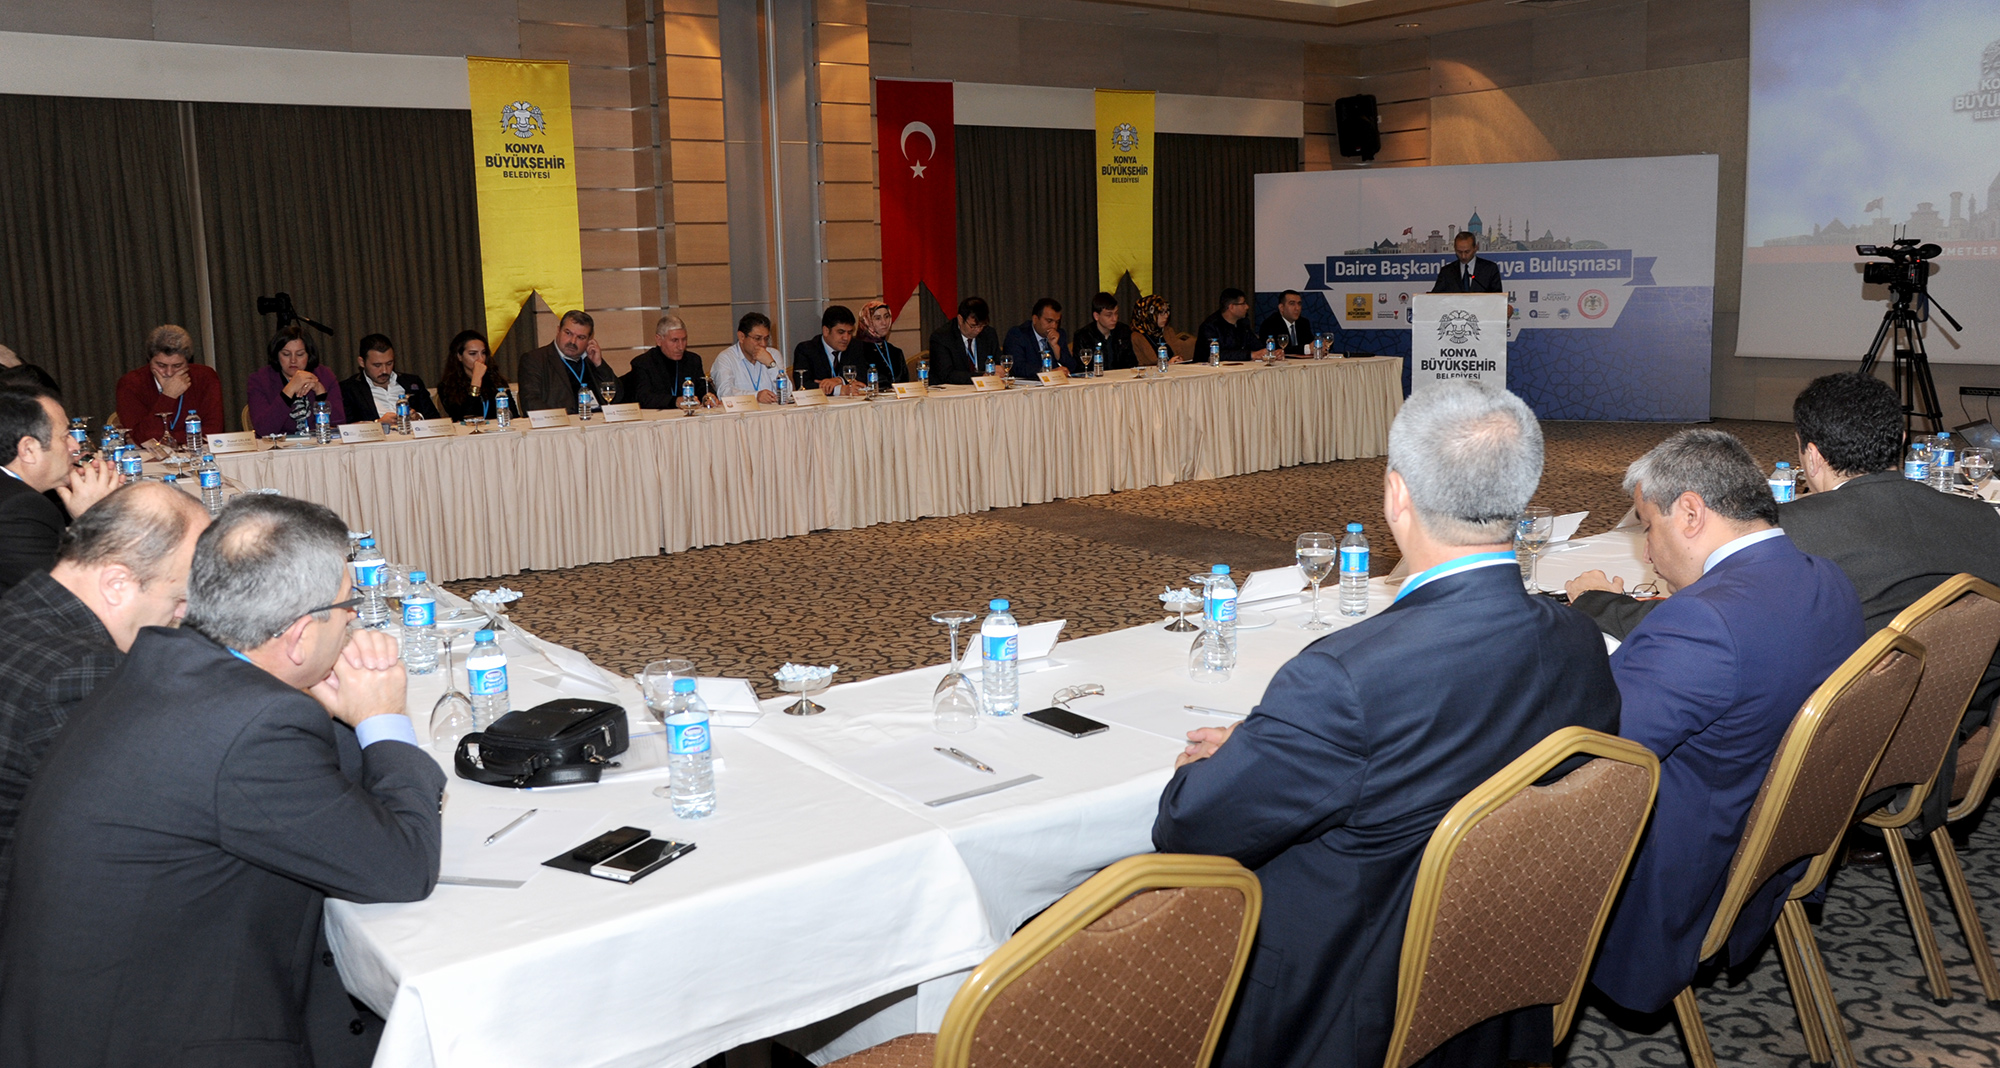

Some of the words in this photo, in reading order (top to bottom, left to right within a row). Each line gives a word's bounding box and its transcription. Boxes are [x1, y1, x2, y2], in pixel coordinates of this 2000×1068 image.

[1955, 90, 2000, 110] BÜYÜ
[505, 143, 545, 154] KONYA
[485, 153, 565, 170] BÜYÜKŞEHİR
[1113, 156, 1137, 164] KONYA
[503, 170, 550, 179] BELEDİYESİ
[1101, 164, 1148, 176] BÜYÜKŞEHİR
[1940, 246, 1997, 256] ZMETLER
[1335, 261, 1377, 276] Daire
[1381, 259, 1452, 280] Başkanl
[1496, 260, 1525, 277] nya
[1529, 256, 1621, 277] Buluşması
[1440, 348, 1478, 358] KONYA
[1421, 357, 1496, 373] BÜYÜKŞEHİR
[1436, 372, 1481, 380] BELEDİYESİ
